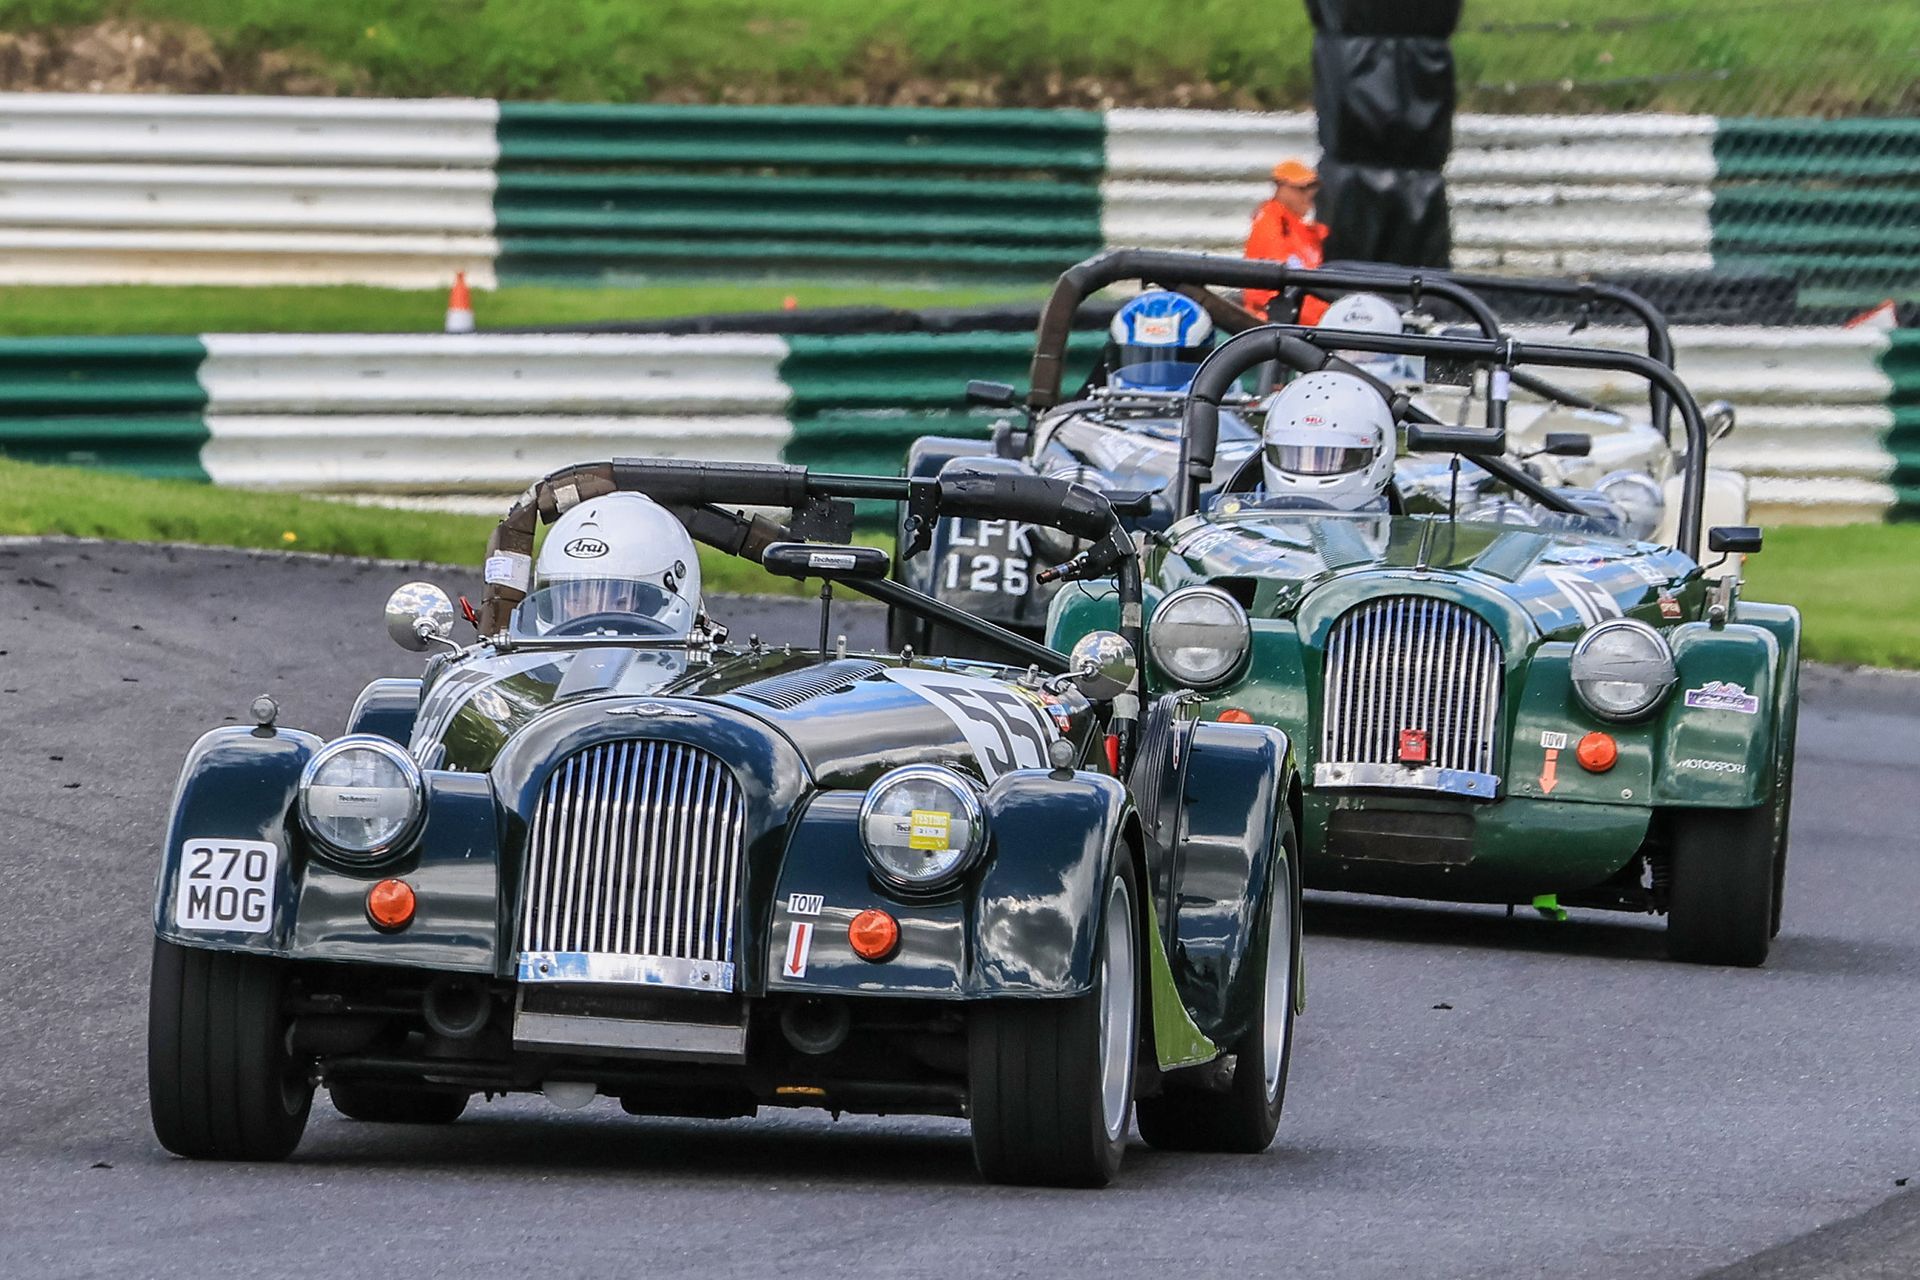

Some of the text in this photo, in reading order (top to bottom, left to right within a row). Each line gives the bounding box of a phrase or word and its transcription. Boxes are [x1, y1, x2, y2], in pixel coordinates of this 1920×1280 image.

[565, 539, 604, 553] Arai
[948, 516, 1033, 557] LFK
[945, 553, 1029, 596] 125
[1543, 732, 1565, 747] TOW
[189, 847, 268, 882] 270
[187, 885, 267, 923] MOG
[792, 895, 822, 913] TOW
